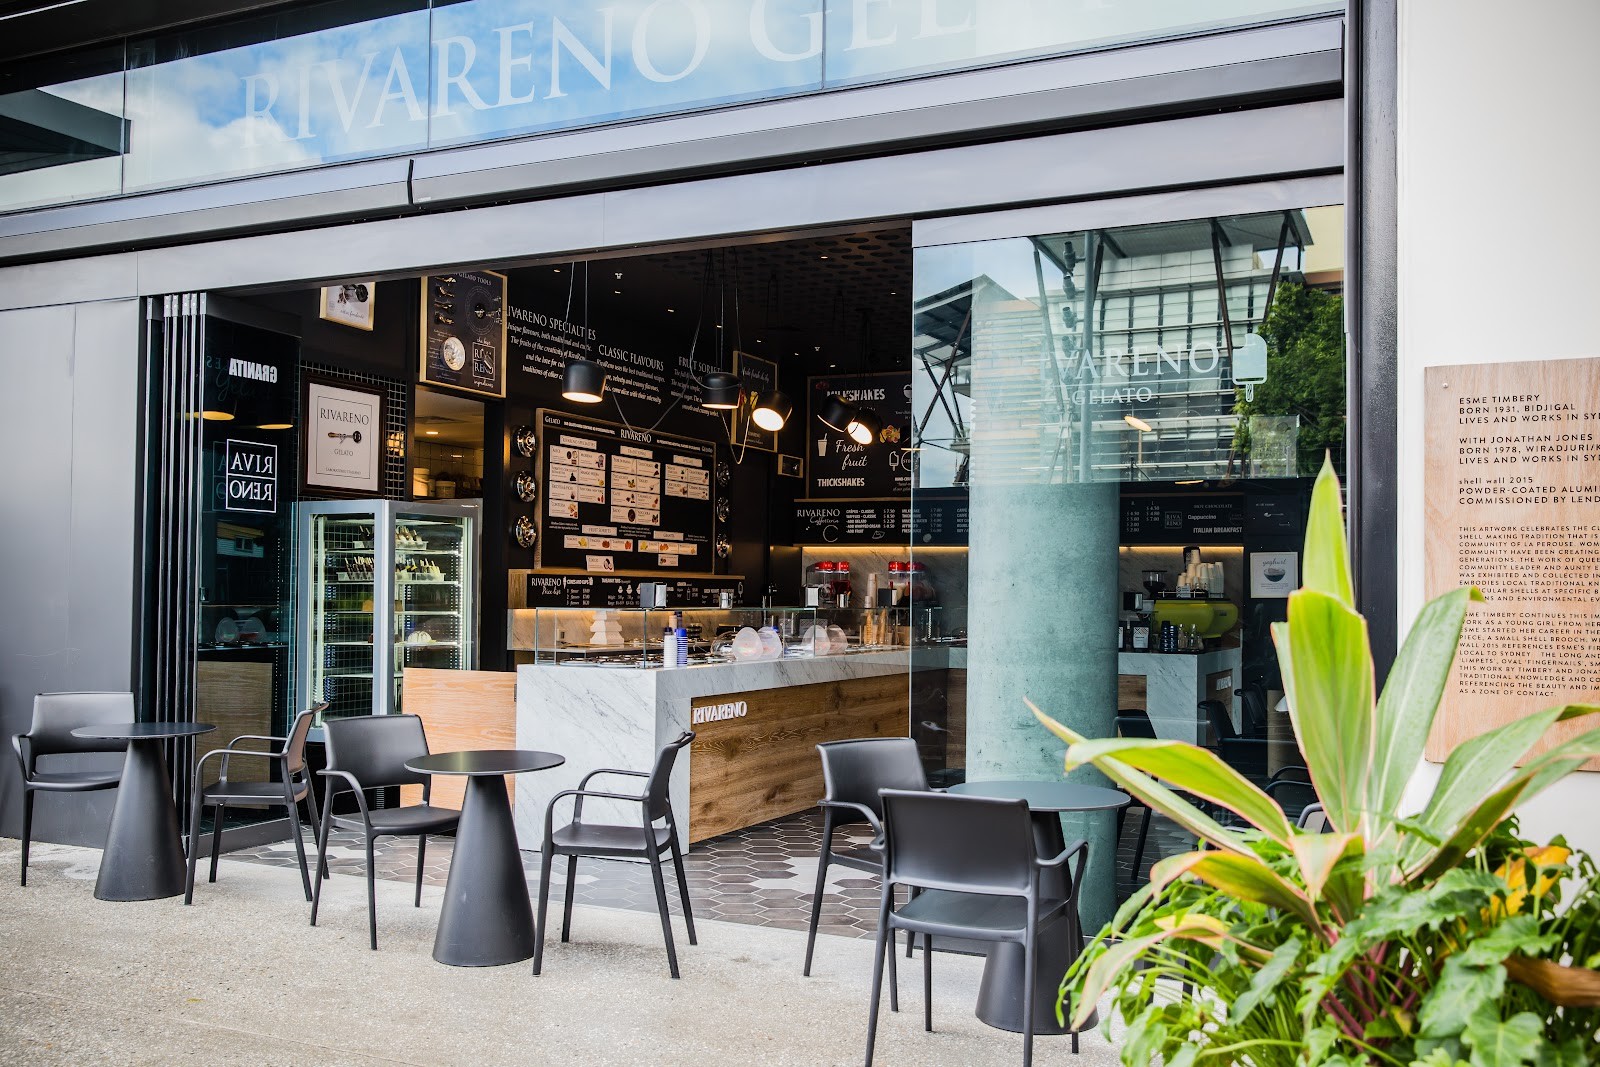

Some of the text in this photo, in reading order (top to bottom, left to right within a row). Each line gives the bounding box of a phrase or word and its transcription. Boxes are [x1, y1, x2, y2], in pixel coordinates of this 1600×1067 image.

[240, 0, 711, 148] RIVARENO
[549, 318, 596, 340] SPECIALTES
[598, 344, 664, 372] CLASSIC FLAVOURS
[678, 356, 697, 370] FRUT
[1072, 387, 1152, 405] GELATO
[1492, 395, 1540, 403] TIMBERY
[1524, 404, 1576, 412] BIDJIGAL
[320, 407, 369, 425] RIVARENO
[1460, 416, 1489, 424] LIVES
[1522, 414, 1562, 422] WORKS
[1567, 413, 1578, 421] IN
[620, 429, 652, 443] RIVARENO
[1491, 435, 1551, 443] JONATHAN
[1556, 434, 1593, 442] JONES
[836, 439, 864, 454] Fresh
[334, 448, 353, 457] GELATO
[842, 455, 868, 470] fruit
[1494, 456, 1517, 464] AND
[1522, 455, 1562, 463] WORKS
[817, 478, 865, 487] THICKSHAKES
[1460, 486, 1556, 495] POWDER-COATED
[1459, 496, 1548, 504] COMMISSIONED
[797, 509, 840, 518] RIVARENO
[531, 578, 562, 586] RIVARENO
[692, 702, 747, 724] RIVARENO
